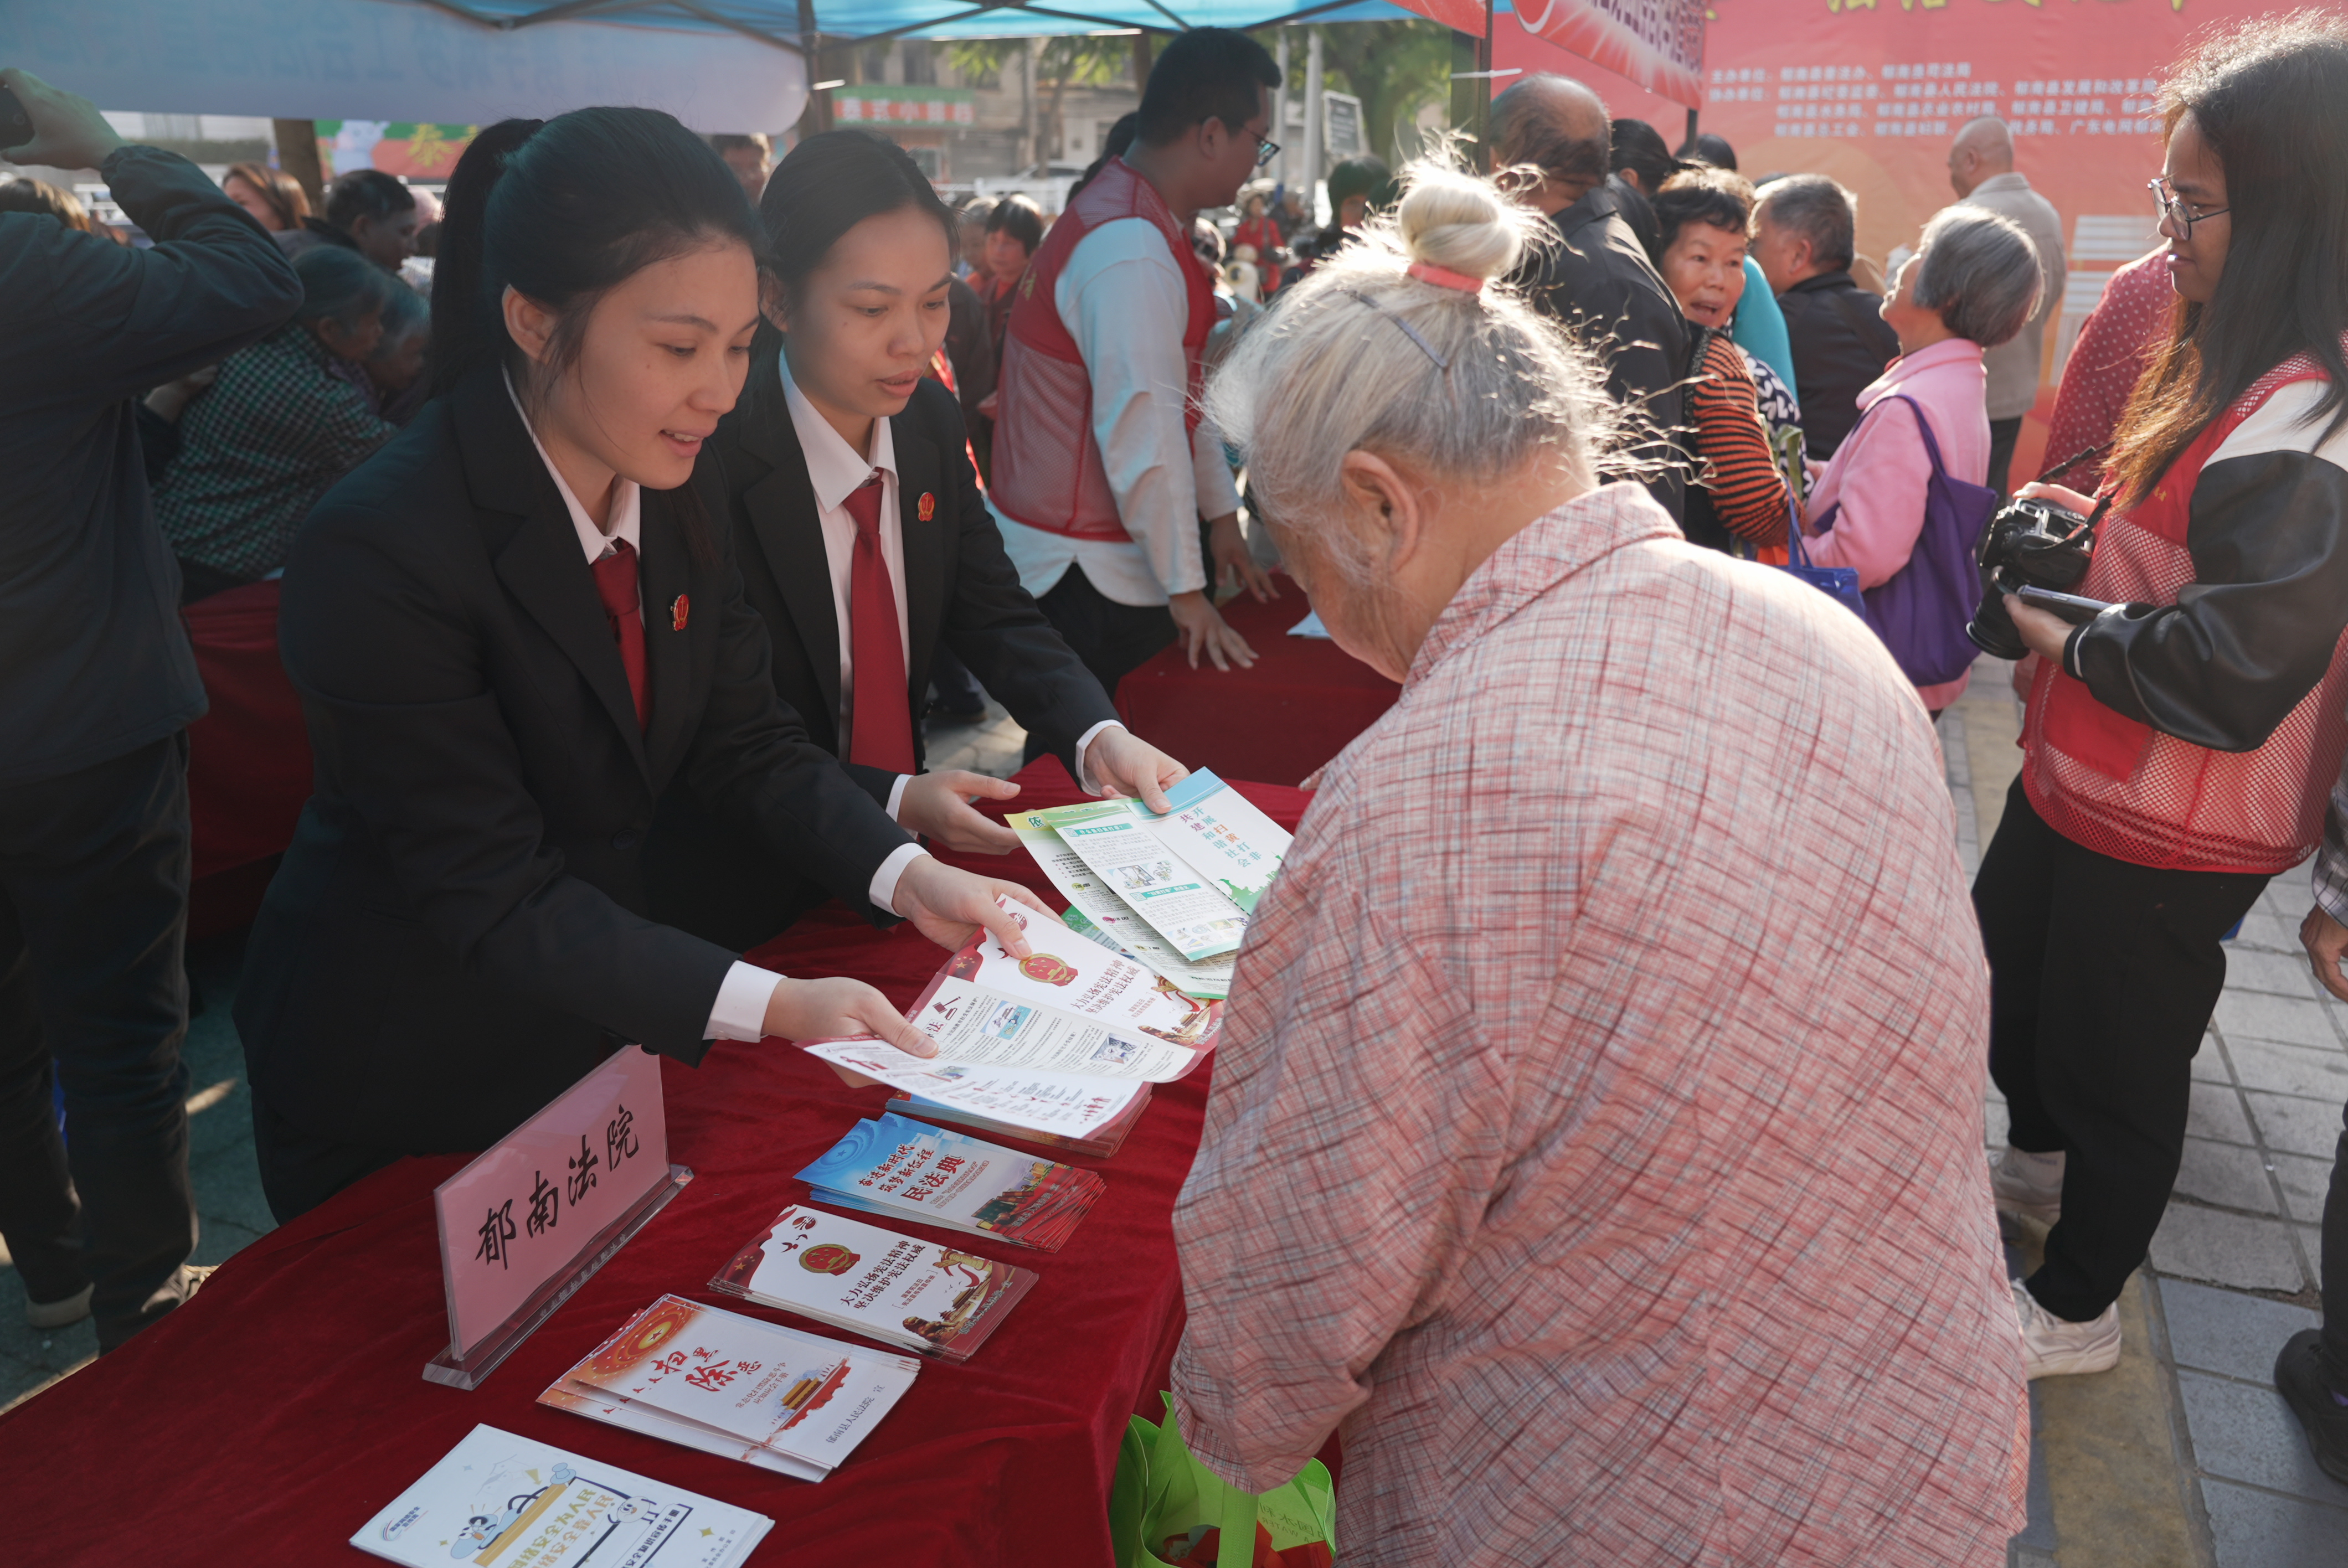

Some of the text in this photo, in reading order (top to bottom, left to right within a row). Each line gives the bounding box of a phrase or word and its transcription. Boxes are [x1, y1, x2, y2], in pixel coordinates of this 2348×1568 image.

[1180, 814, 1251, 868] 共建和谐社会
[1192, 806, 1262, 860] 开展扫黄打非
[1070, 959, 1125, 1009] 大力弘扬宪法精神
[1085, 965, 1140, 1014] 坚决维护宪法权威
[475, 1105, 640, 1270] 郁南法院
[857, 1143, 915, 1187] 奋进新时代
[878, 1148, 935, 1193] 筑梦新征程
[900, 1153, 966, 1201] 民法典
[840, 1240, 910, 1306] 大力弘扬宪法精神
[853, 1244, 926, 1311] 坚决维护宪法权威
[650, 1347, 719, 1374] 扫黑
[684, 1359, 762, 1391] 除恶
[735, 1362, 786, 1408] 常态化扫黑除恶斗争
[753, 1372, 789, 1404] 应知应会手册
[825, 1396, 875, 1443] 郁南县人民法院
[532, 1493, 614, 1568] 络安全靠人民
[621, 1509, 680, 1568] 安全知识宣传手册
[705, 1539, 732, 1568] 委员会办公室
